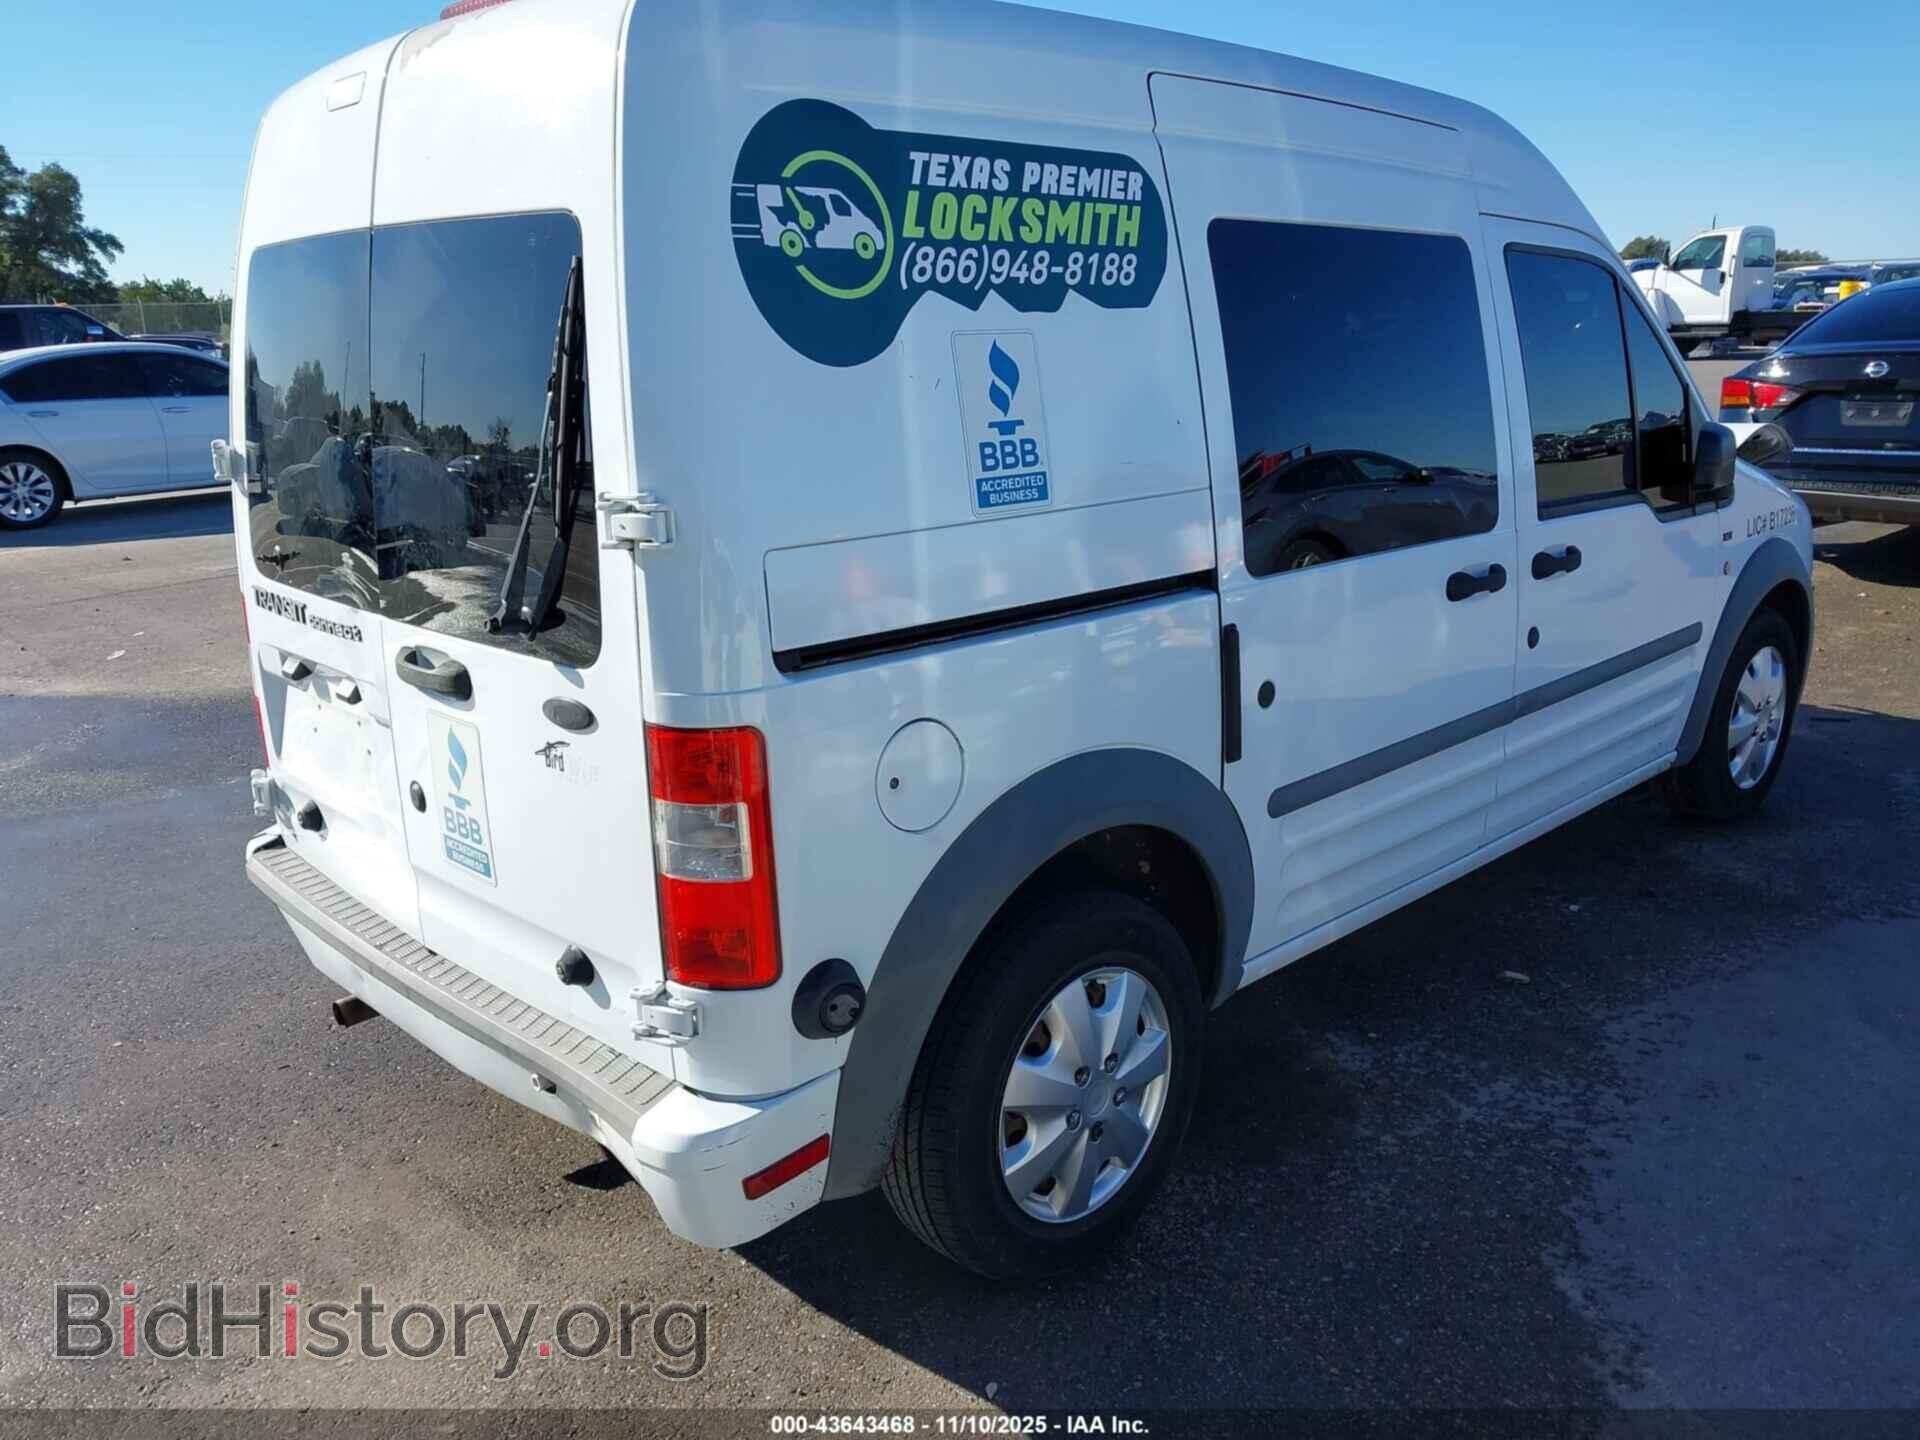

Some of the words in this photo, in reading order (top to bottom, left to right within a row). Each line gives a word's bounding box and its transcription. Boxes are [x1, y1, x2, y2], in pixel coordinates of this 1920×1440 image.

[909, 151, 1011, 191] TEXAS
[1022, 162, 1144, 201] PREMIER
[902, 190, 1142, 248] LOCKSMITH
[900, 241, 1138, 291] (866)948-8188
[979, 438, 1040, 472] BBB
[981, 475, 1045, 492] ACCREDITED
[989, 488, 1039, 504] BUSINESS
[252, 586, 308, 625] TRANSIT
[443, 806, 483, 846] BBB
